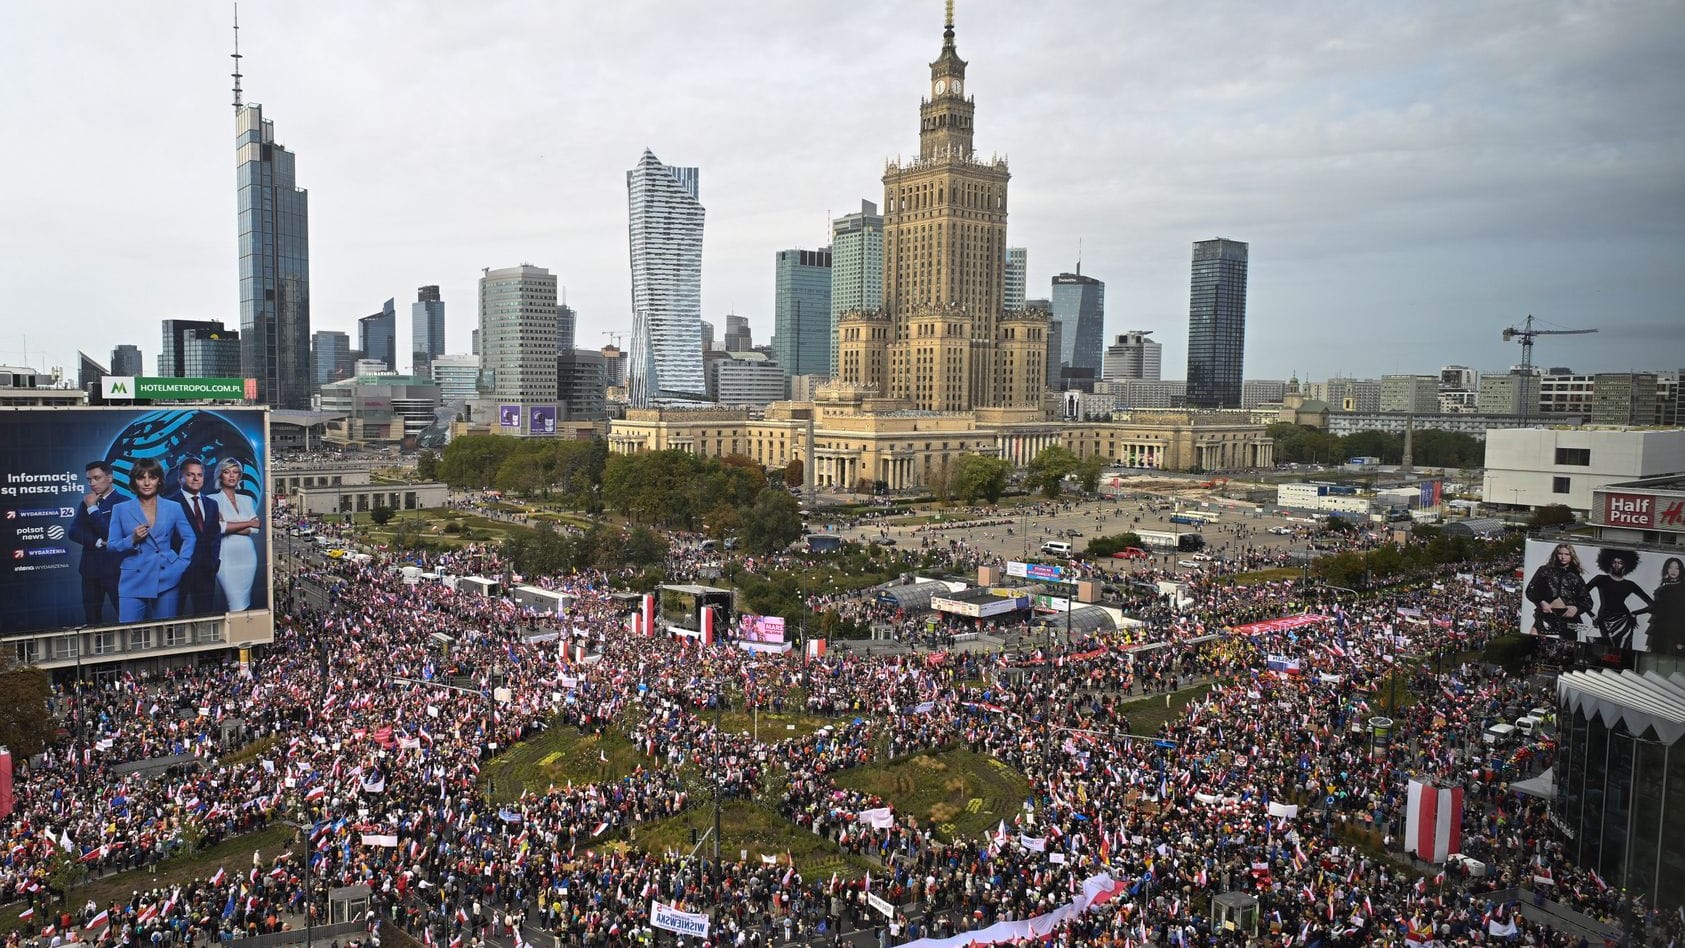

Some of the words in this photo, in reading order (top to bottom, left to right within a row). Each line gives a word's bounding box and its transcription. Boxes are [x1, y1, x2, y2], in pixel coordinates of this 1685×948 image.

[140, 384, 242, 393] HOTELMETROPOL.COM.PL
[7, 471, 78, 483] Informacje
[1, 487, 17, 497] są
[19, 485, 59, 495] naszą
[61, 482, 85, 494] siłą
[1611, 497, 1650, 513] Half
[62, 508, 73, 517] 24
[1610, 510, 1649, 524] Price
[16, 526, 44, 535] polsat
[28, 548, 67, 556] WYDARZENIA
